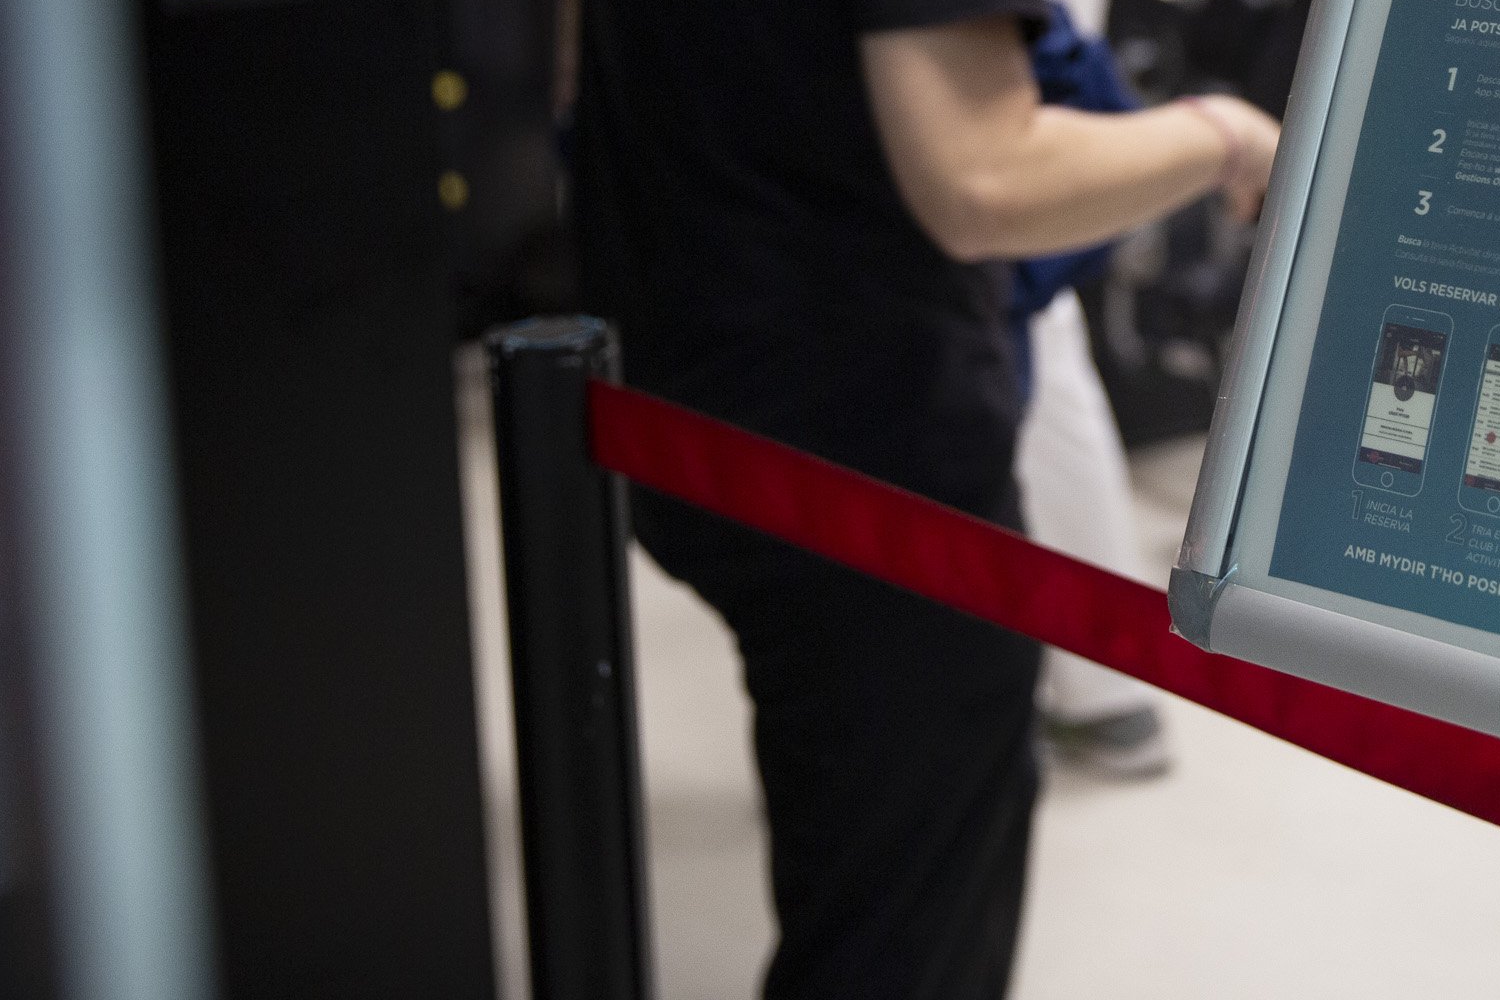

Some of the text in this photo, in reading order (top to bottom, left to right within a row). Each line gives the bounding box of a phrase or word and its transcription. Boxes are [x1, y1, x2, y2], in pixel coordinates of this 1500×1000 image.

[1451, 18, 1467, 32] JA
[1447, 67, 1458, 91] 1
[1473, 87, 1492, 98] App
[1427, 128, 1447, 154] 2
[1454, 170, 1491, 184] Gestions
[1414, 190, 1433, 215] 3
[1397, 234, 1422, 246] Busca
[1393, 275, 1426, 294] VOLS
[1429, 282, 1498, 307] RESERVAR
[1350, 490, 1364, 520] 1
[1365, 499, 1414, 520] INICIA LA
[1363, 512, 1411, 533] RESERVA
[1445, 512, 1468, 546] 2
[1471, 524, 1493, 539] TRIA
[1468, 537, 1494, 553] CLUB
[1344, 544, 1375, 564] AMB
[1379, 553, 1425, 577] MYDIR
[1430, 564, 1464, 586] T'HO
